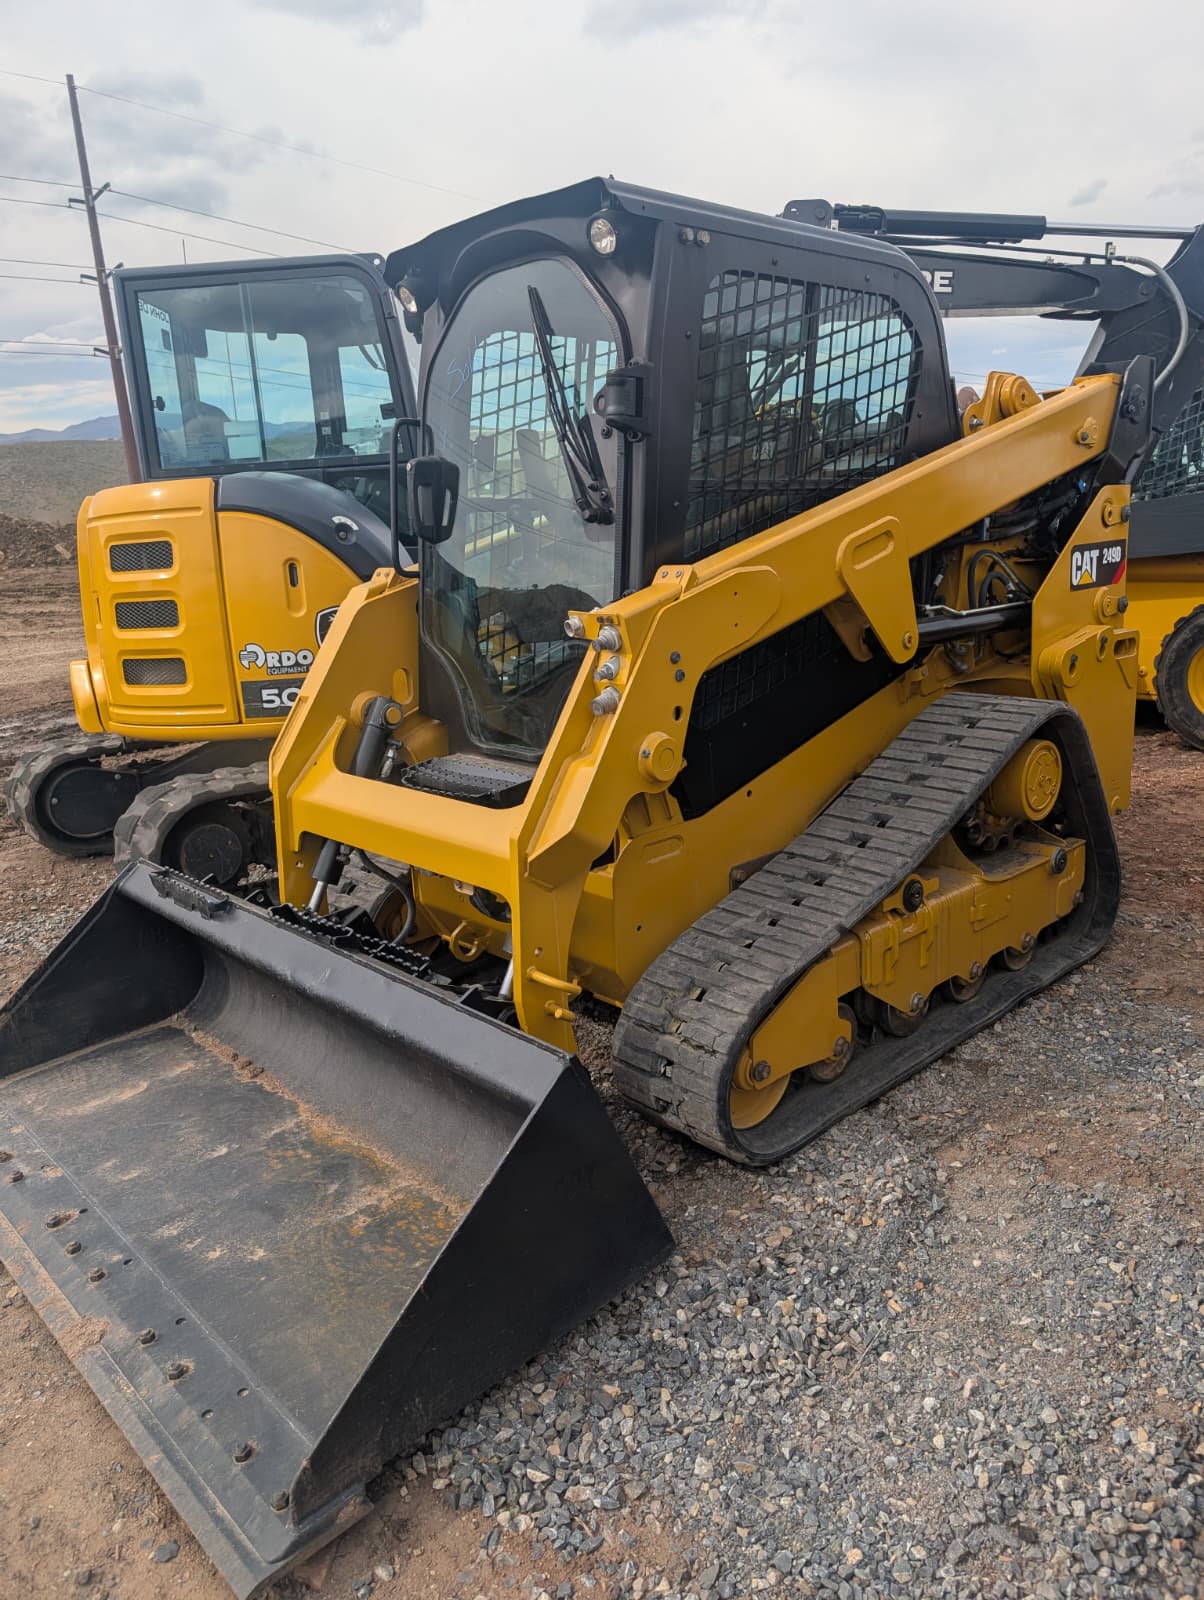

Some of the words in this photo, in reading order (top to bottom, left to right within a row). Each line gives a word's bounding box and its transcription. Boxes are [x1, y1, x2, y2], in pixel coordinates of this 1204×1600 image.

[1071, 549, 1100, 586] CAT
[1102, 546, 1122, 564] 249D
[267, 666, 307, 675] EQUIPMENT
